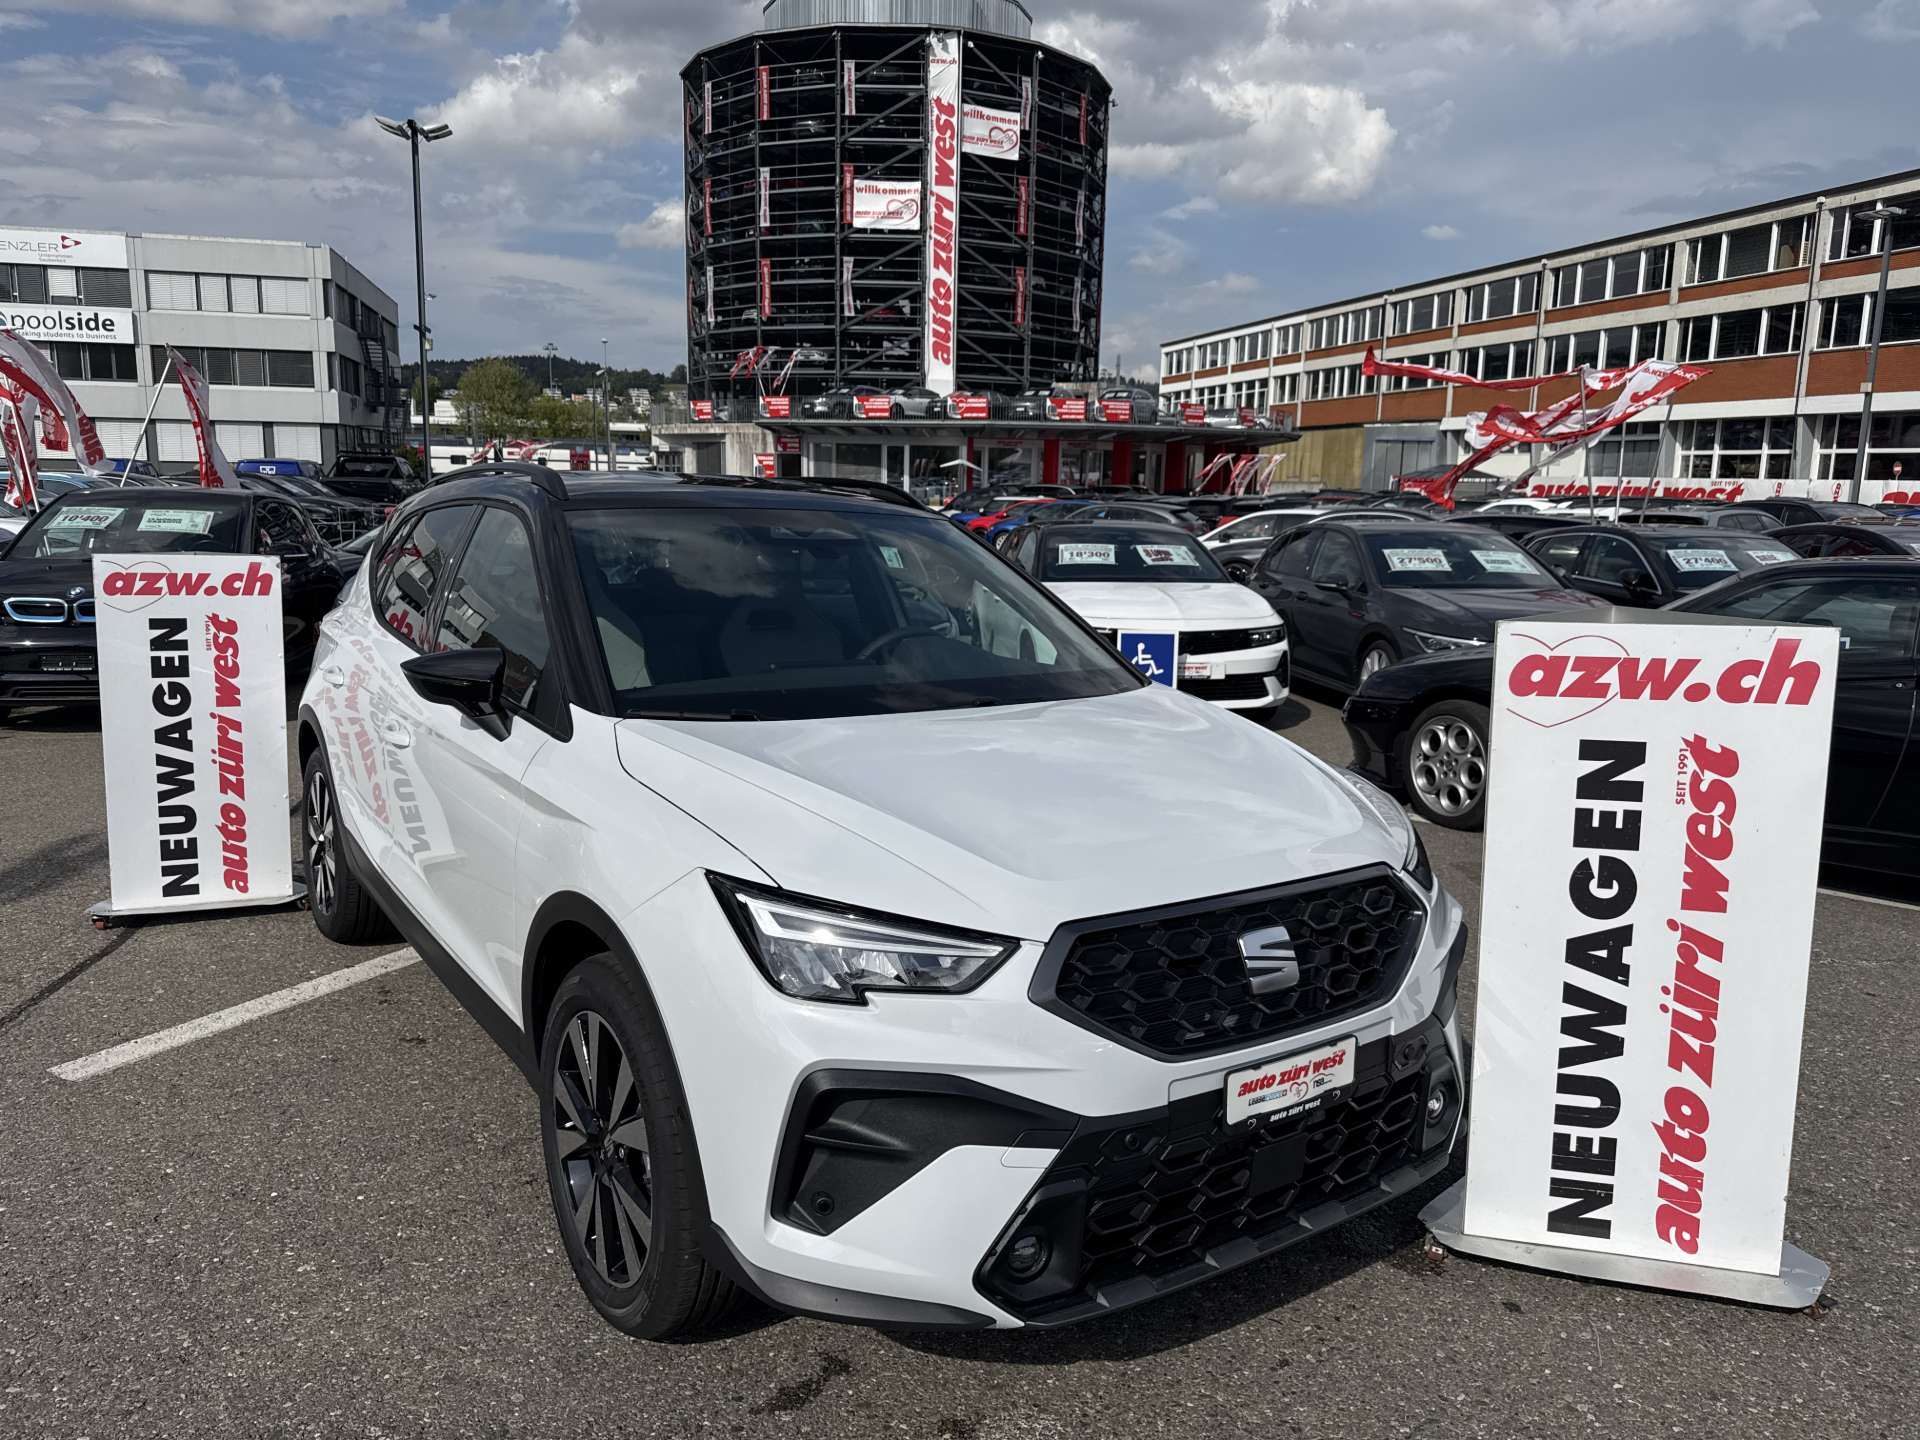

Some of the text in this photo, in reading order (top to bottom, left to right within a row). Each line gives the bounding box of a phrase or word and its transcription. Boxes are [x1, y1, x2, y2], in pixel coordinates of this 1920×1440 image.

[962, 108, 1019, 125] willkommen
[855, 184, 921, 196] willkommen
[928, 96, 956, 365] auto züri west
[11, 310, 115, 332] poolside
[43, 331, 75, 339] students
[85, 332, 117, 341] business
[1663, 478, 1744, 503] west
[1068, 550, 1111, 559] 18'300
[102, 562, 273, 597] azw.ch
[1508, 638, 1821, 706] azw.ch
[148, 617, 200, 898] NEUWAGEN
[210, 612, 249, 894] auto züri west
[1675, 748, 1689, 806] SEIT 1991
[1547, 738, 1648, 1241] NEUWAGEN
[1651, 733, 1741, 1255] auto züri west
[1237, 1075, 1276, 1098] auto
[1277, 1060, 1312, 1087] züri
[1312, 1049, 1347, 1075] west
[1269, 1110, 1288, 1122] auto
[1305, 1098, 1321, 1111] west
